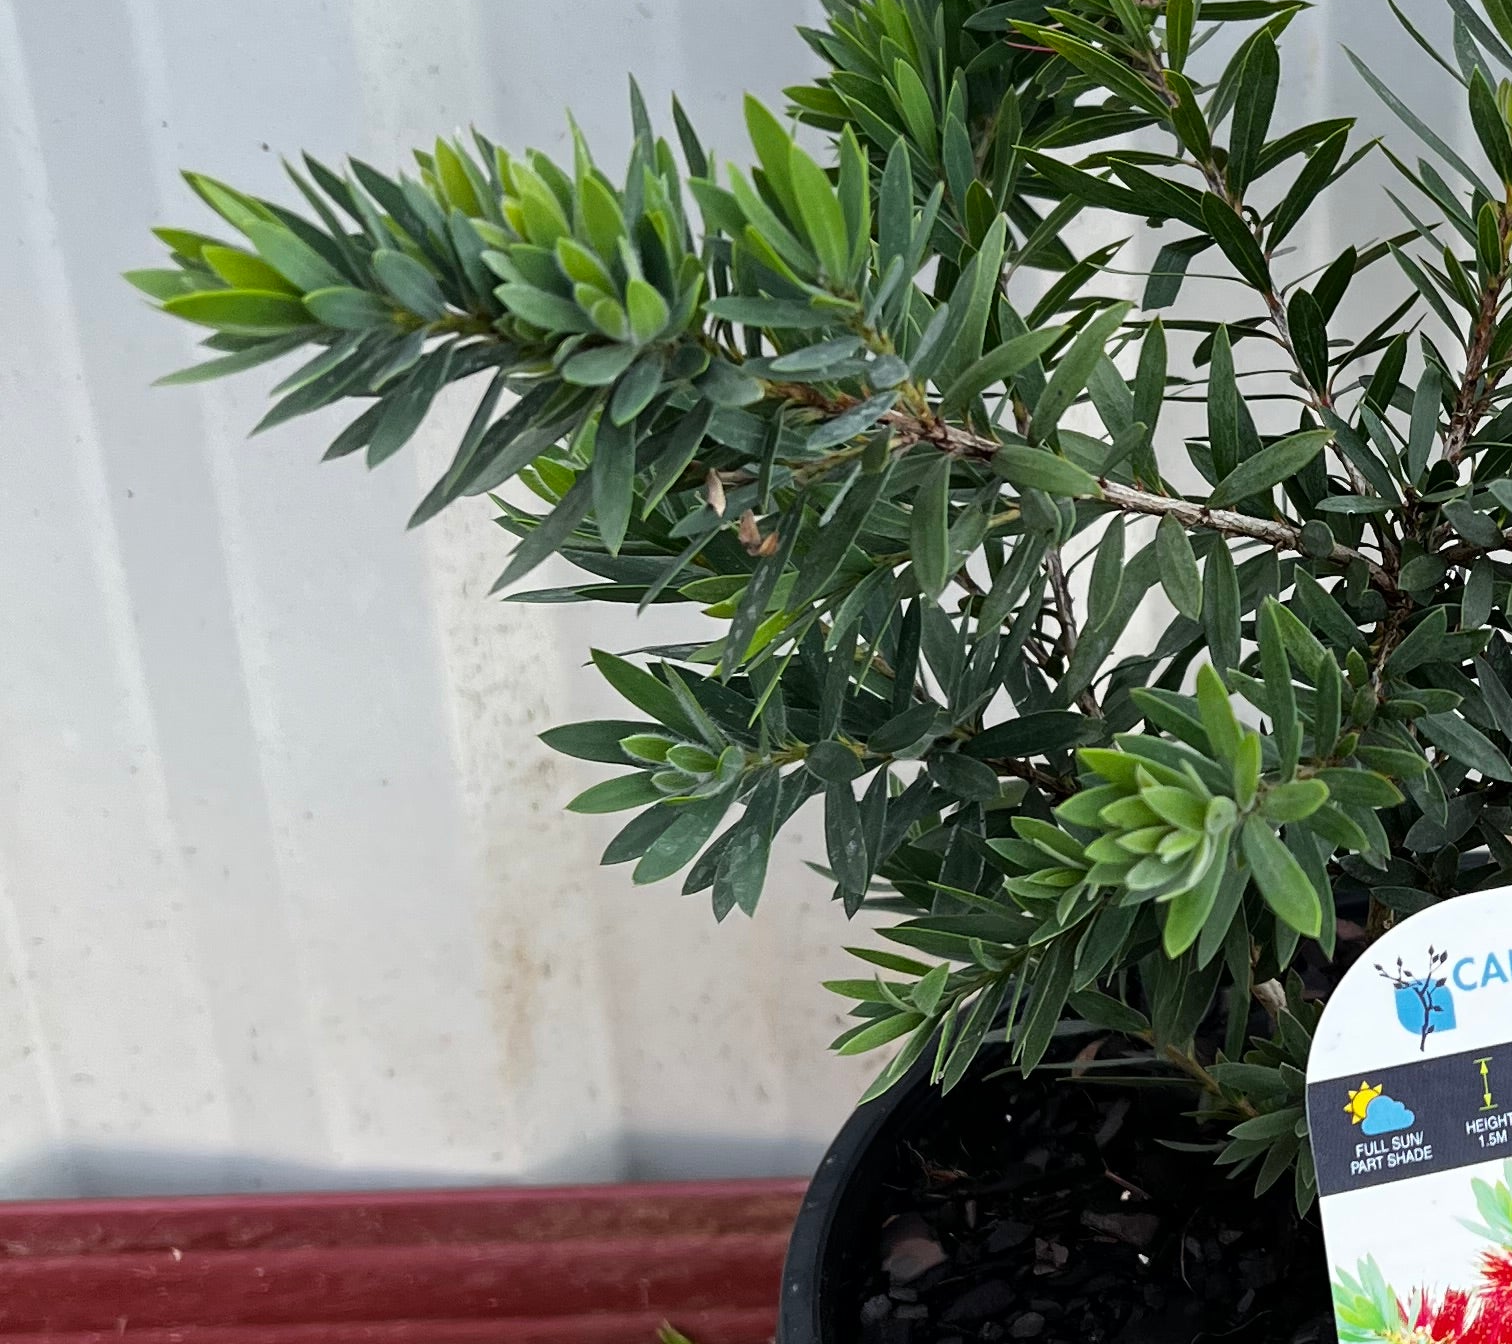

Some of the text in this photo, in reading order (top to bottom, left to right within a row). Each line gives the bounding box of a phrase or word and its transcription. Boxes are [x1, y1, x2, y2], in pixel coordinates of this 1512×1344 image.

[1355, 1130, 1424, 1158] FULL SUN/
[1478, 1129, 1508, 1148] 1.5M
[1350, 1145, 1433, 1176] PART SHADE
